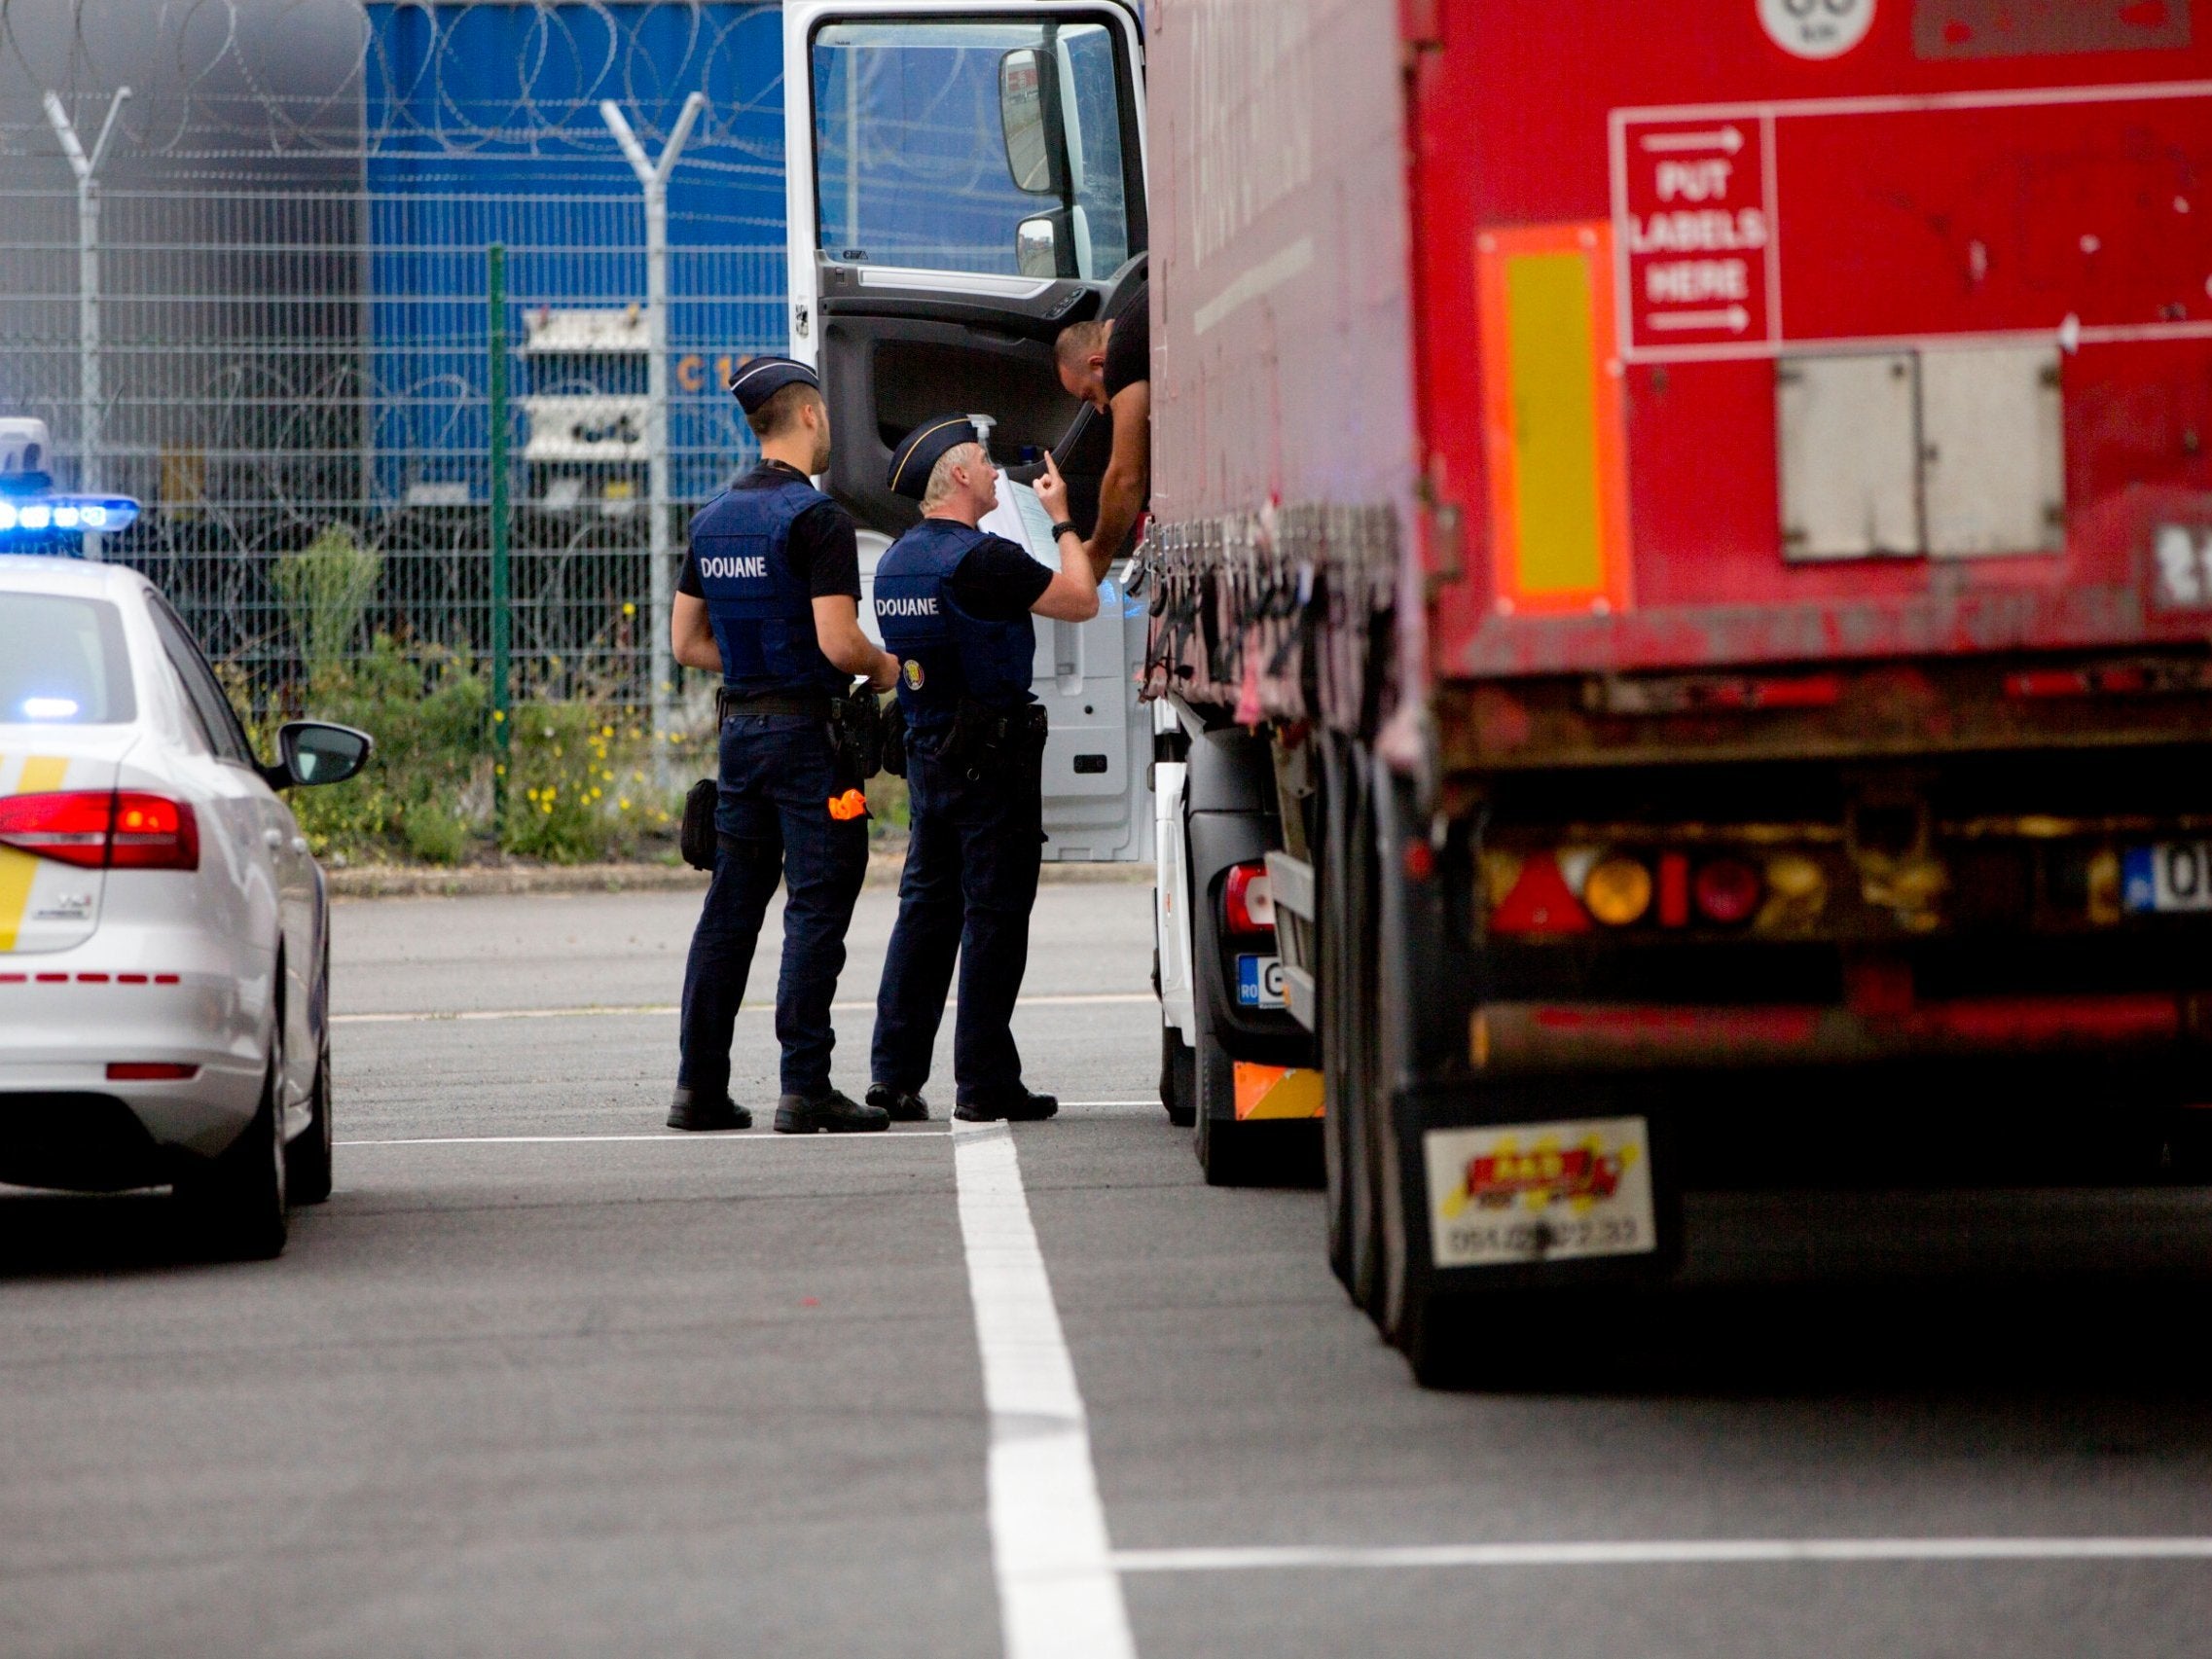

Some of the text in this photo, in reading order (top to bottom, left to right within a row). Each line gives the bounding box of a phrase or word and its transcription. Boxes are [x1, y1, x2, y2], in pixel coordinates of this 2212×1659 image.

[1656, 160, 1732, 201] PUT
[1628, 209, 1767, 254] LABELS
[1645, 260, 1749, 302] HERE
[701, 557, 767, 578] DOUANE
[876, 597, 939, 617] DOUANE
[1241, 984, 1258, 999] RO
